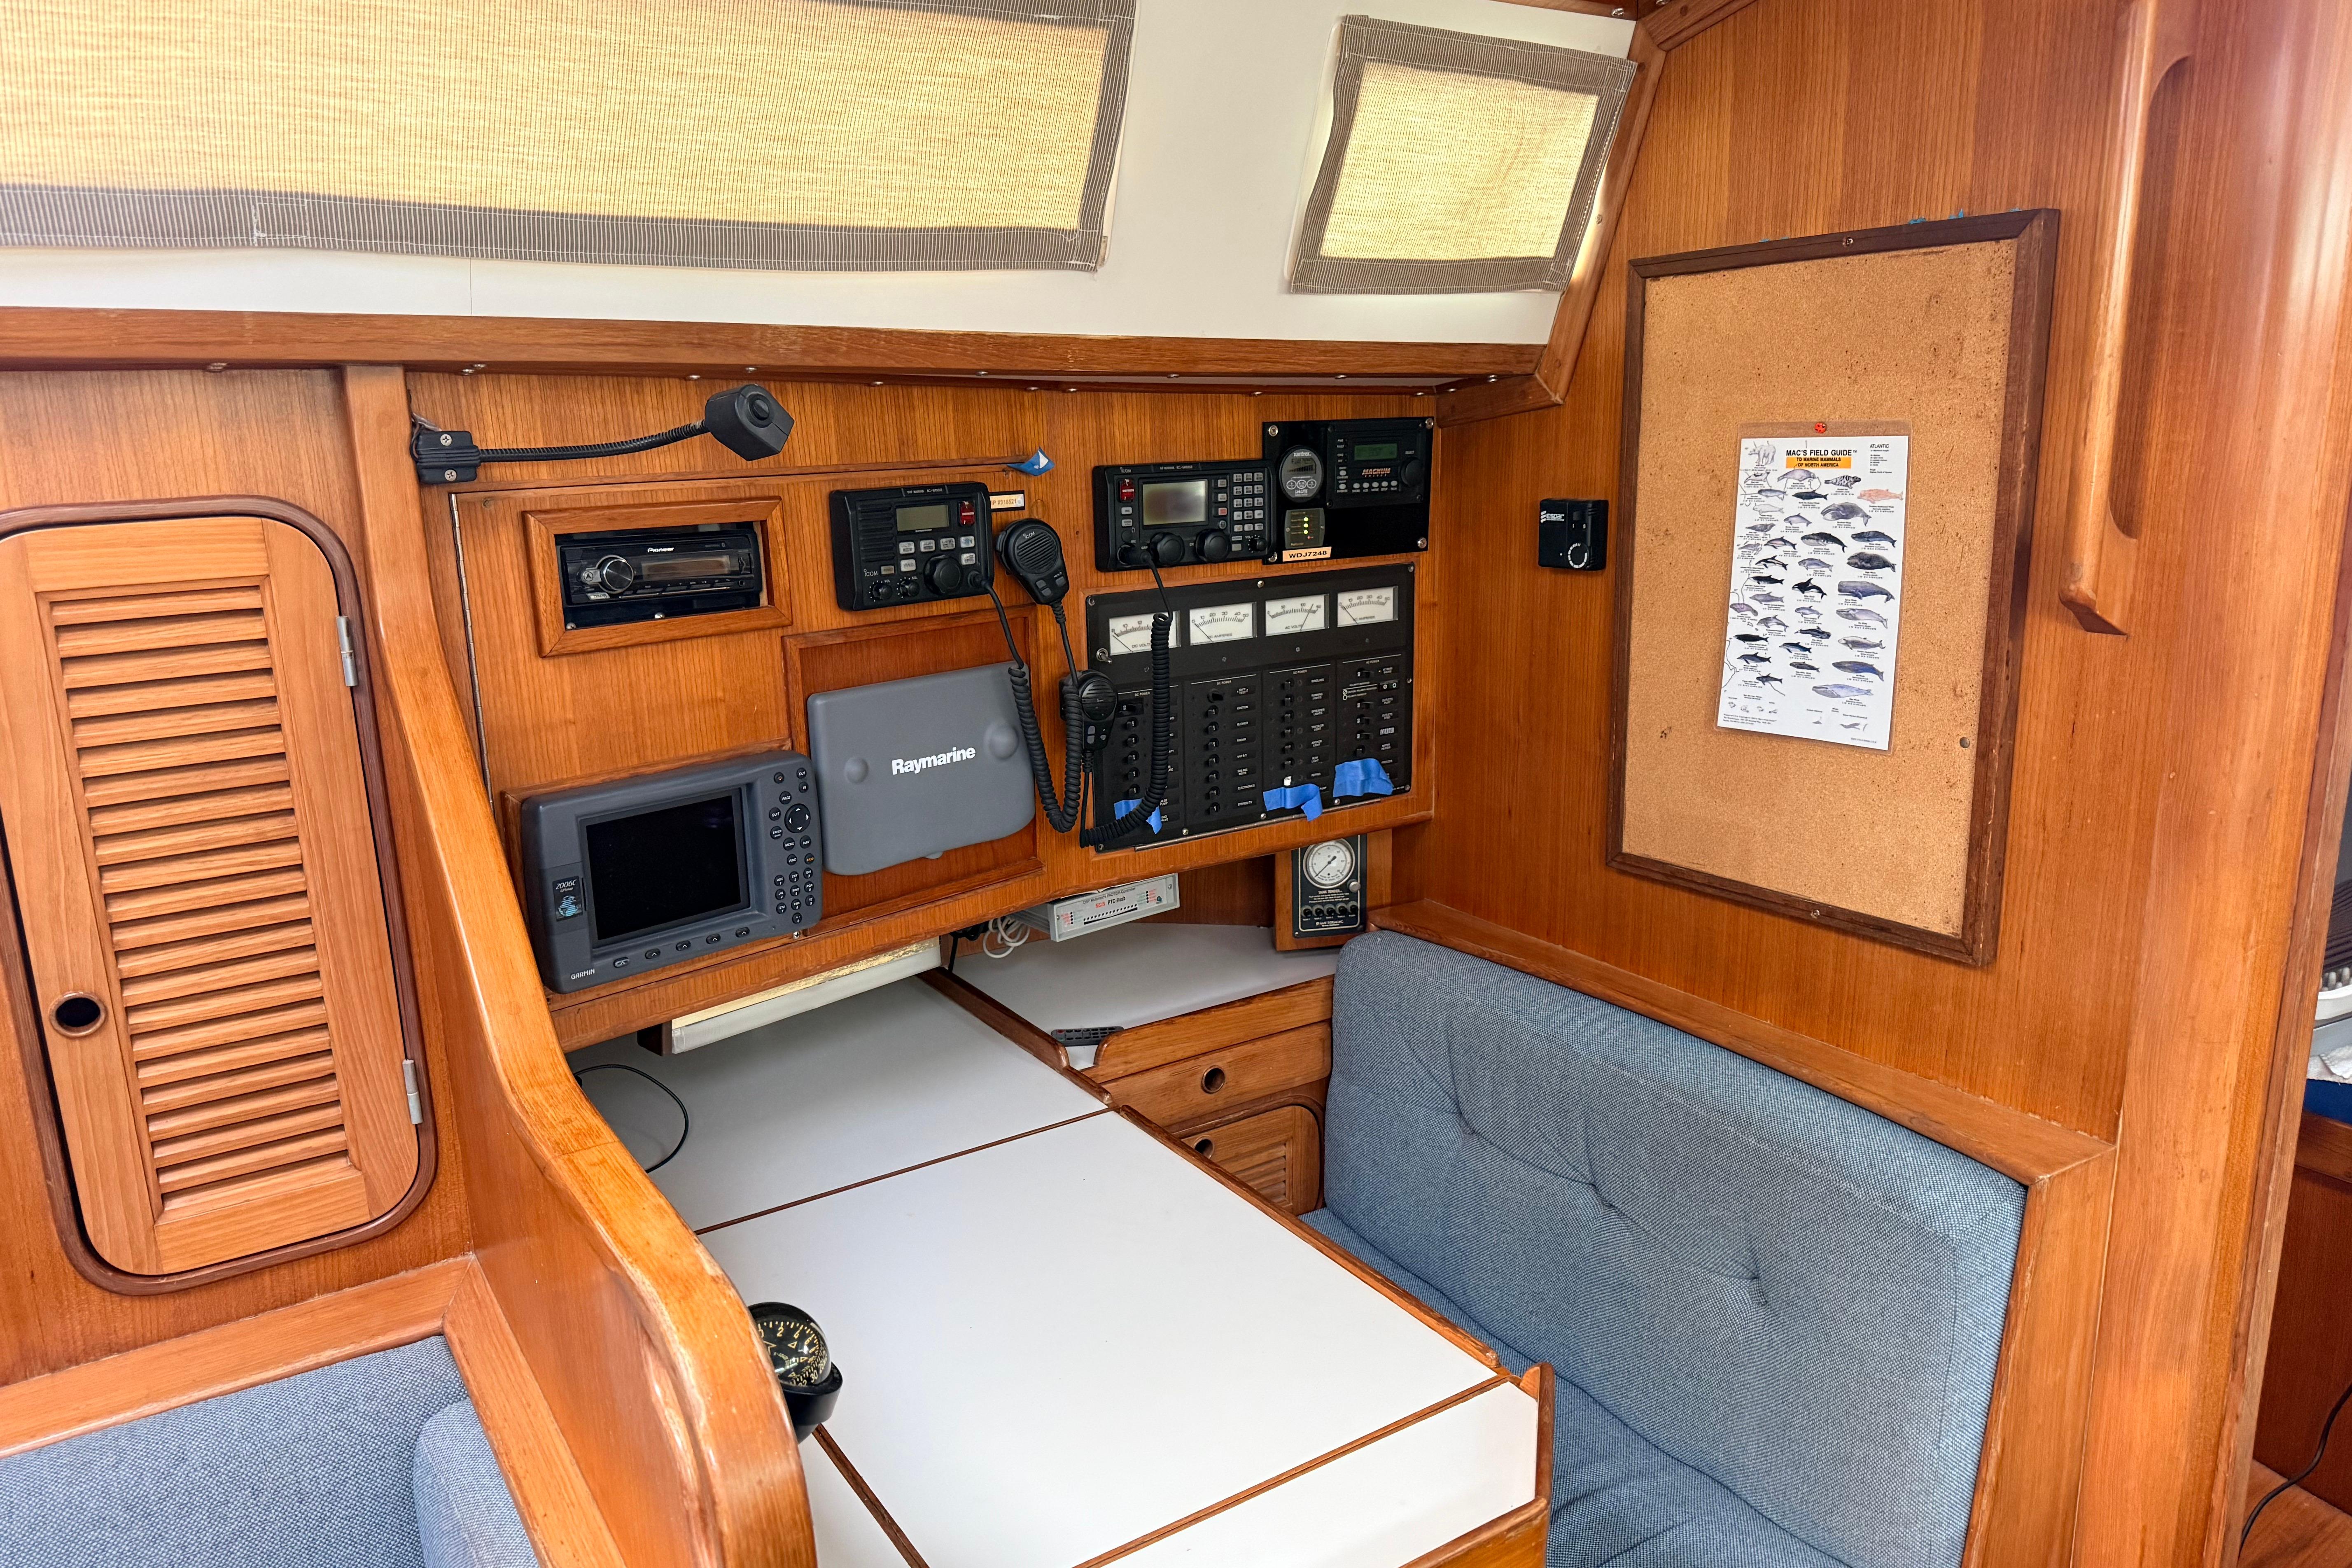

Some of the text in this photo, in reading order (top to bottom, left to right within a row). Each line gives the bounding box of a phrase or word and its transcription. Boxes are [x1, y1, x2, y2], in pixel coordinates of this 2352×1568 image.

[892, 747, 976, 775] Raymarine
[555, 879, 577, 890] 2006C
[571, 968, 595, 980] GARMIN
[777, 1327, 784, 1337] 2
